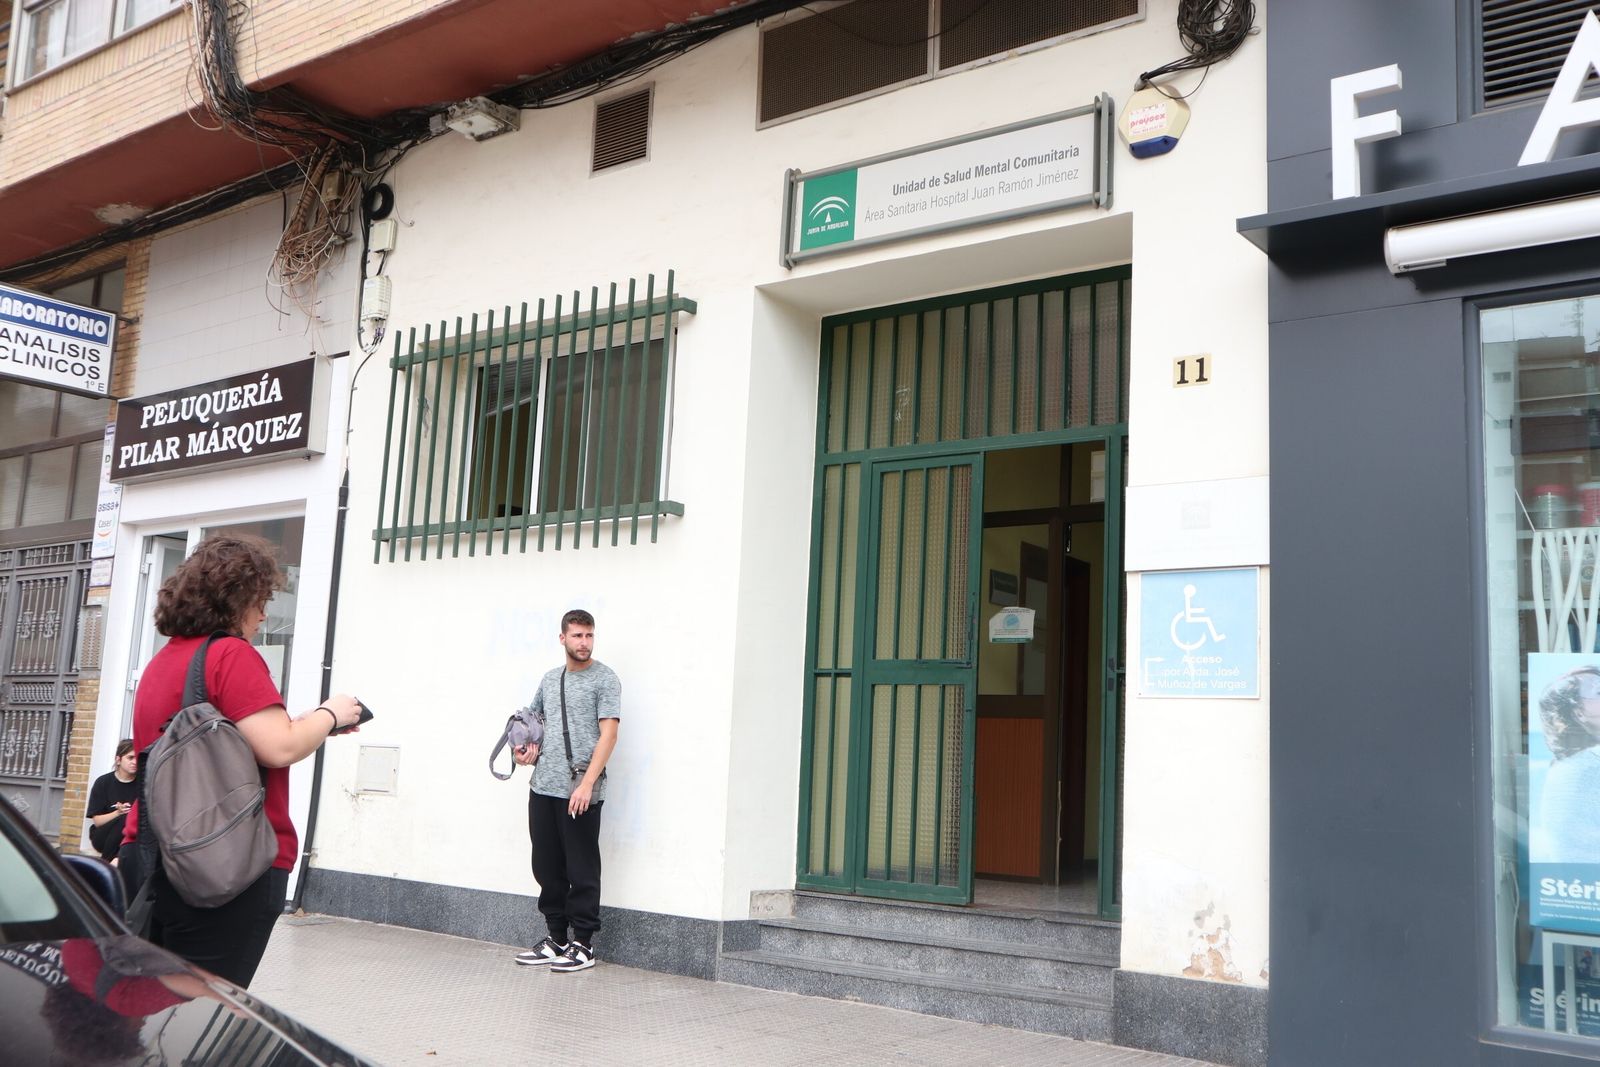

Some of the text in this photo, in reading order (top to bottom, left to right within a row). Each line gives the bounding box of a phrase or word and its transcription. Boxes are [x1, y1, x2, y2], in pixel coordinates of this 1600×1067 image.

[892, 145, 1080, 196] Unidad de Salud Mental Comunitaria
[864, 168, 1079, 223] Área Sanitaria Hospital Juan Ramón Jiménez
[0, 328, 101, 363] ANALISIS
[0, 345, 101, 380] CLINICOS
[97, 383, 105, 392] E
[1176, 357, 1208, 385] 11
[140, 373, 283, 429] PELUQUERÍA
[118, 412, 303, 469] PILAR MÁRQUEZ
[1182, 655, 1223, 664] Acceso
[1215, 666, 1240, 676] José
[1157, 680, 1247, 691] Muñoz de Vargas
